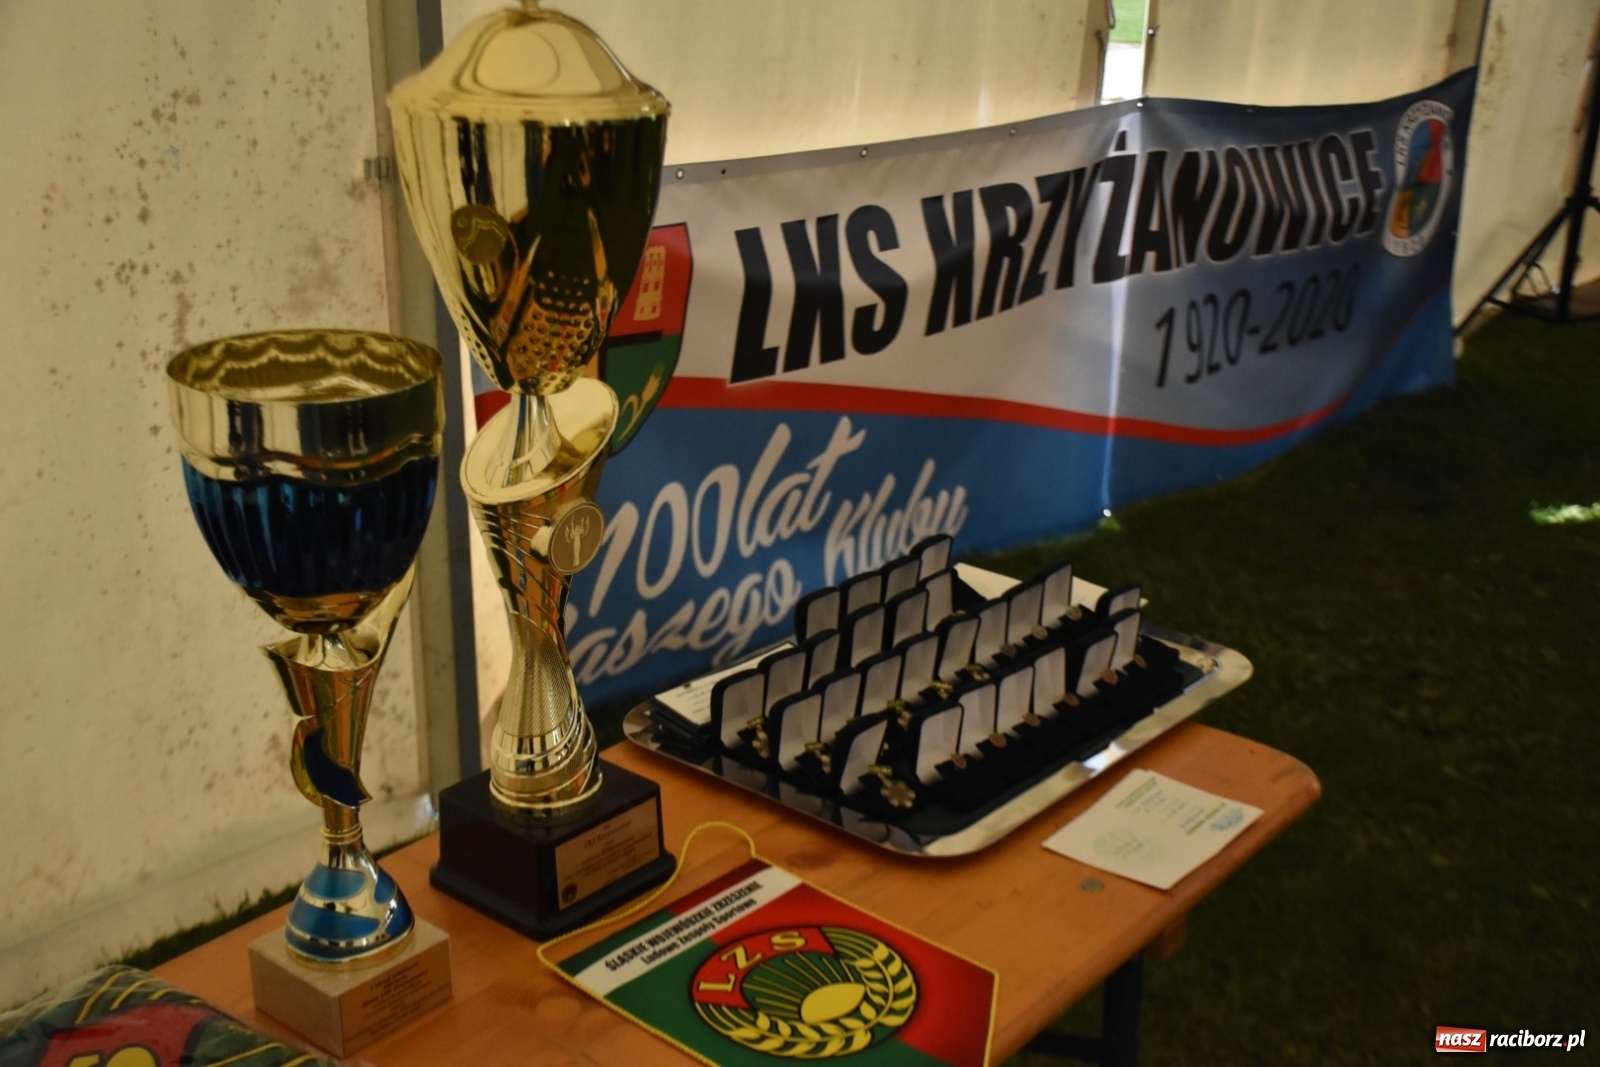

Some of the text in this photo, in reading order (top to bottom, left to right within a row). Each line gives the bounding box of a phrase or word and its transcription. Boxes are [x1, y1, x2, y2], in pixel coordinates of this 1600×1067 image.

[729, 128, 1382, 384] LKS KRZYŻANOWICE
[1155, 262, 1360, 388] 1920-2020
[605, 880, 764, 971] ŚLĄSKIE WOJEWÓDZKIE ZRZESZENIE
[641, 942, 680, 965] Ludowe
[711, 898, 757, 924] Sportowe
[699, 930, 806, 992] LZS
